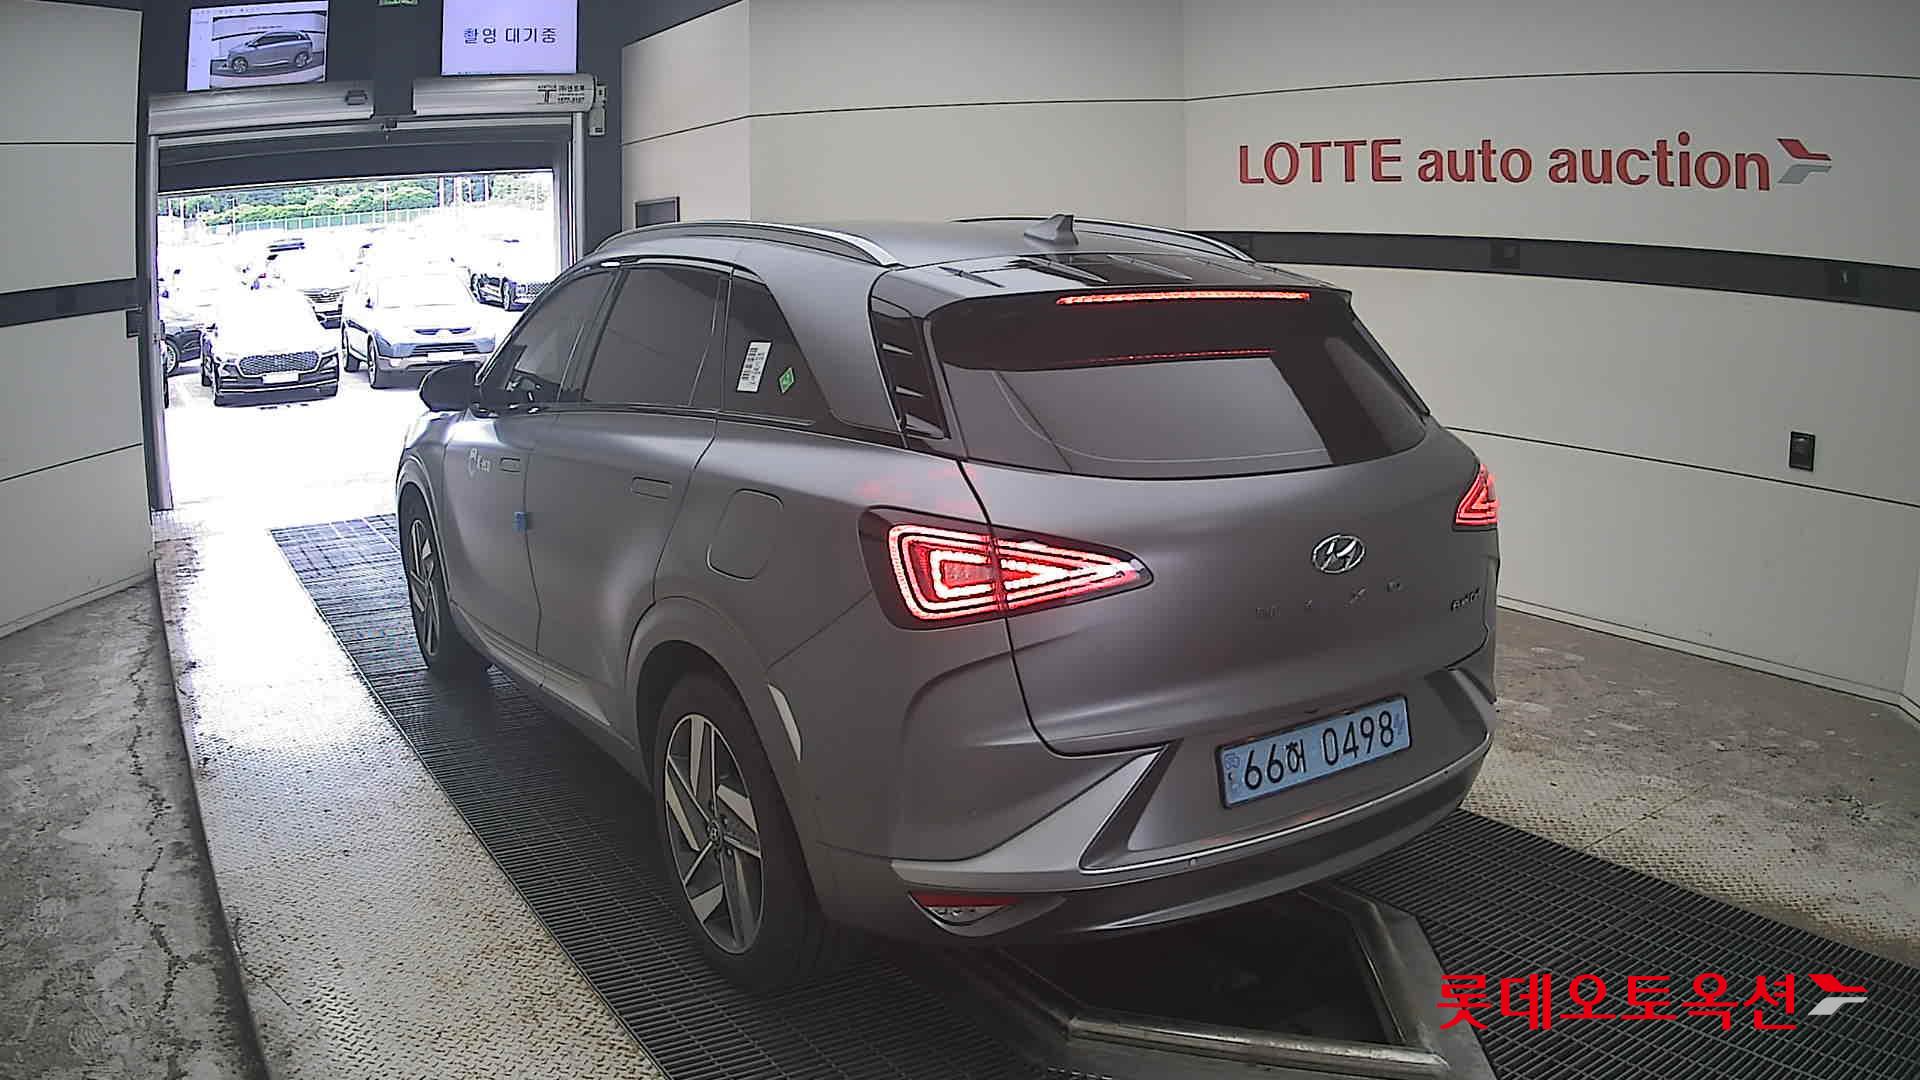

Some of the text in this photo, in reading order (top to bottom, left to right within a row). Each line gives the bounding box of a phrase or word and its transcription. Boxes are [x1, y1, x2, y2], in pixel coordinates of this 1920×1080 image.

[464, 27, 557, 45] 촬영 대기중
[1239, 131, 1771, 191] LOTTE auto auction
[1244, 710, 1394, 790] 66허 0498
